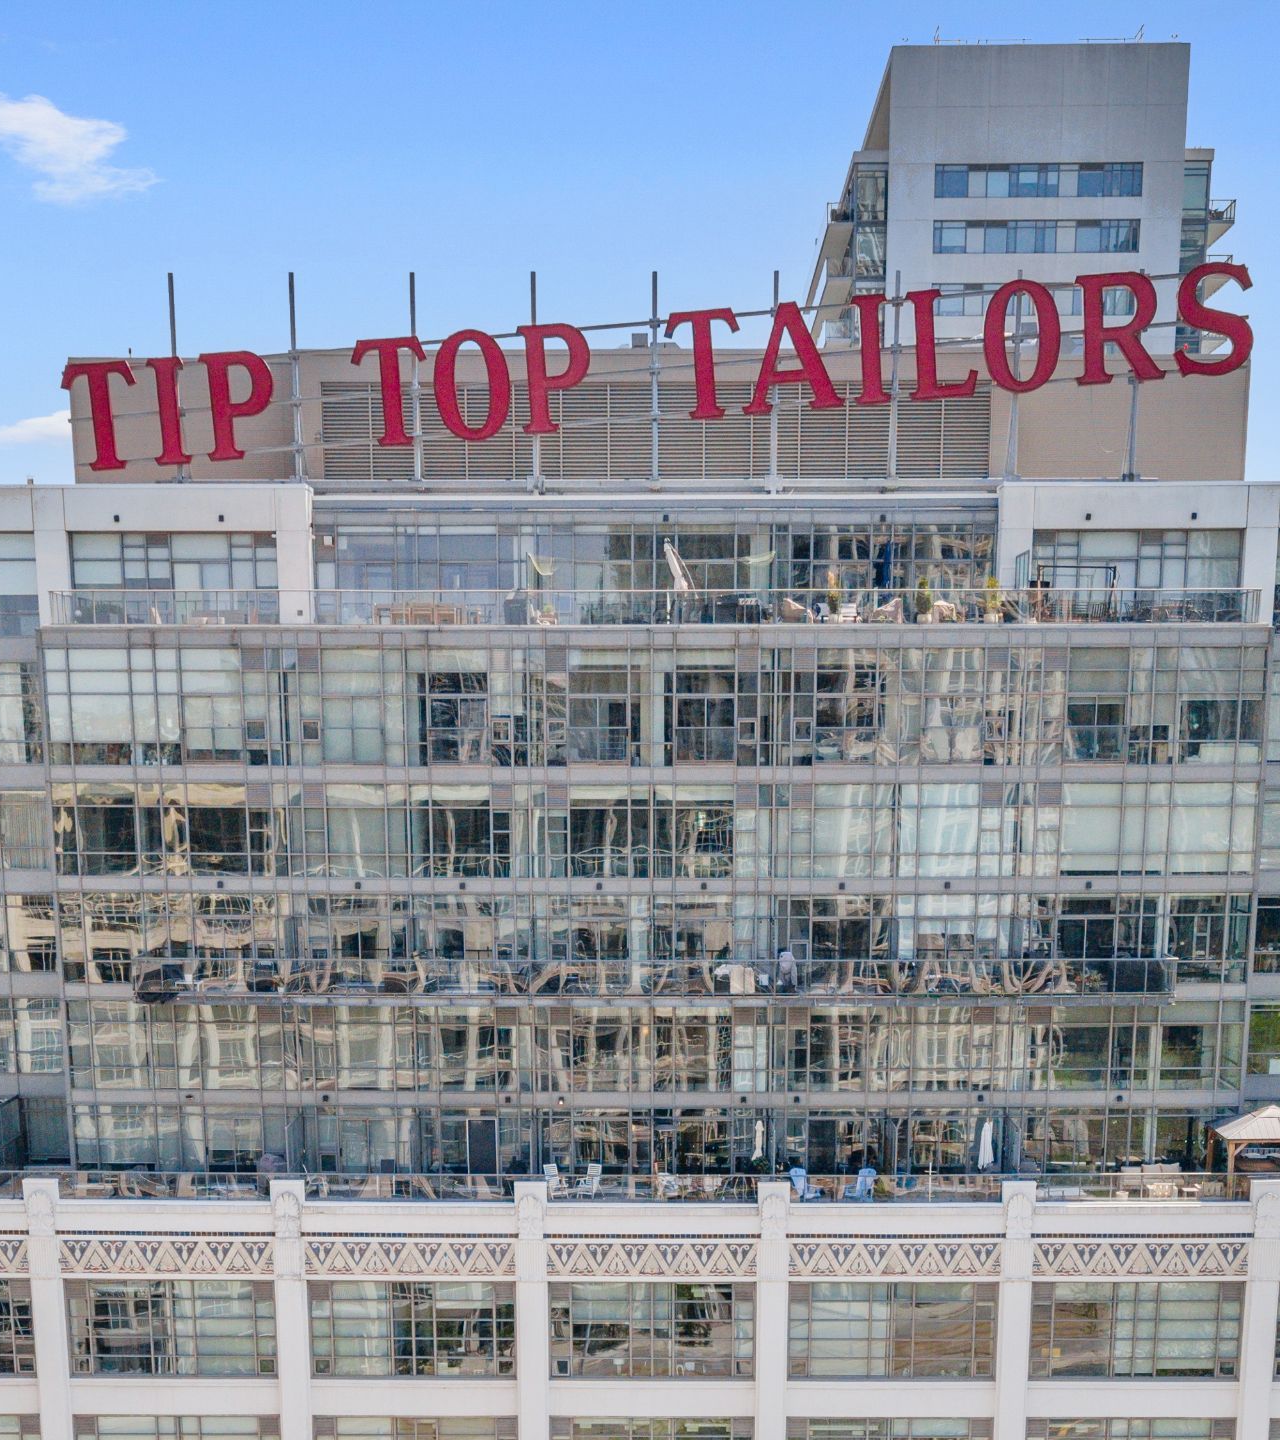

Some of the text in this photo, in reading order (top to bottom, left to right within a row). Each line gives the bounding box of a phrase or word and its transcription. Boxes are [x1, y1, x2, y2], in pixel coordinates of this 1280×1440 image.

[62, 262, 1254, 471] TIP TOP TAILORS
